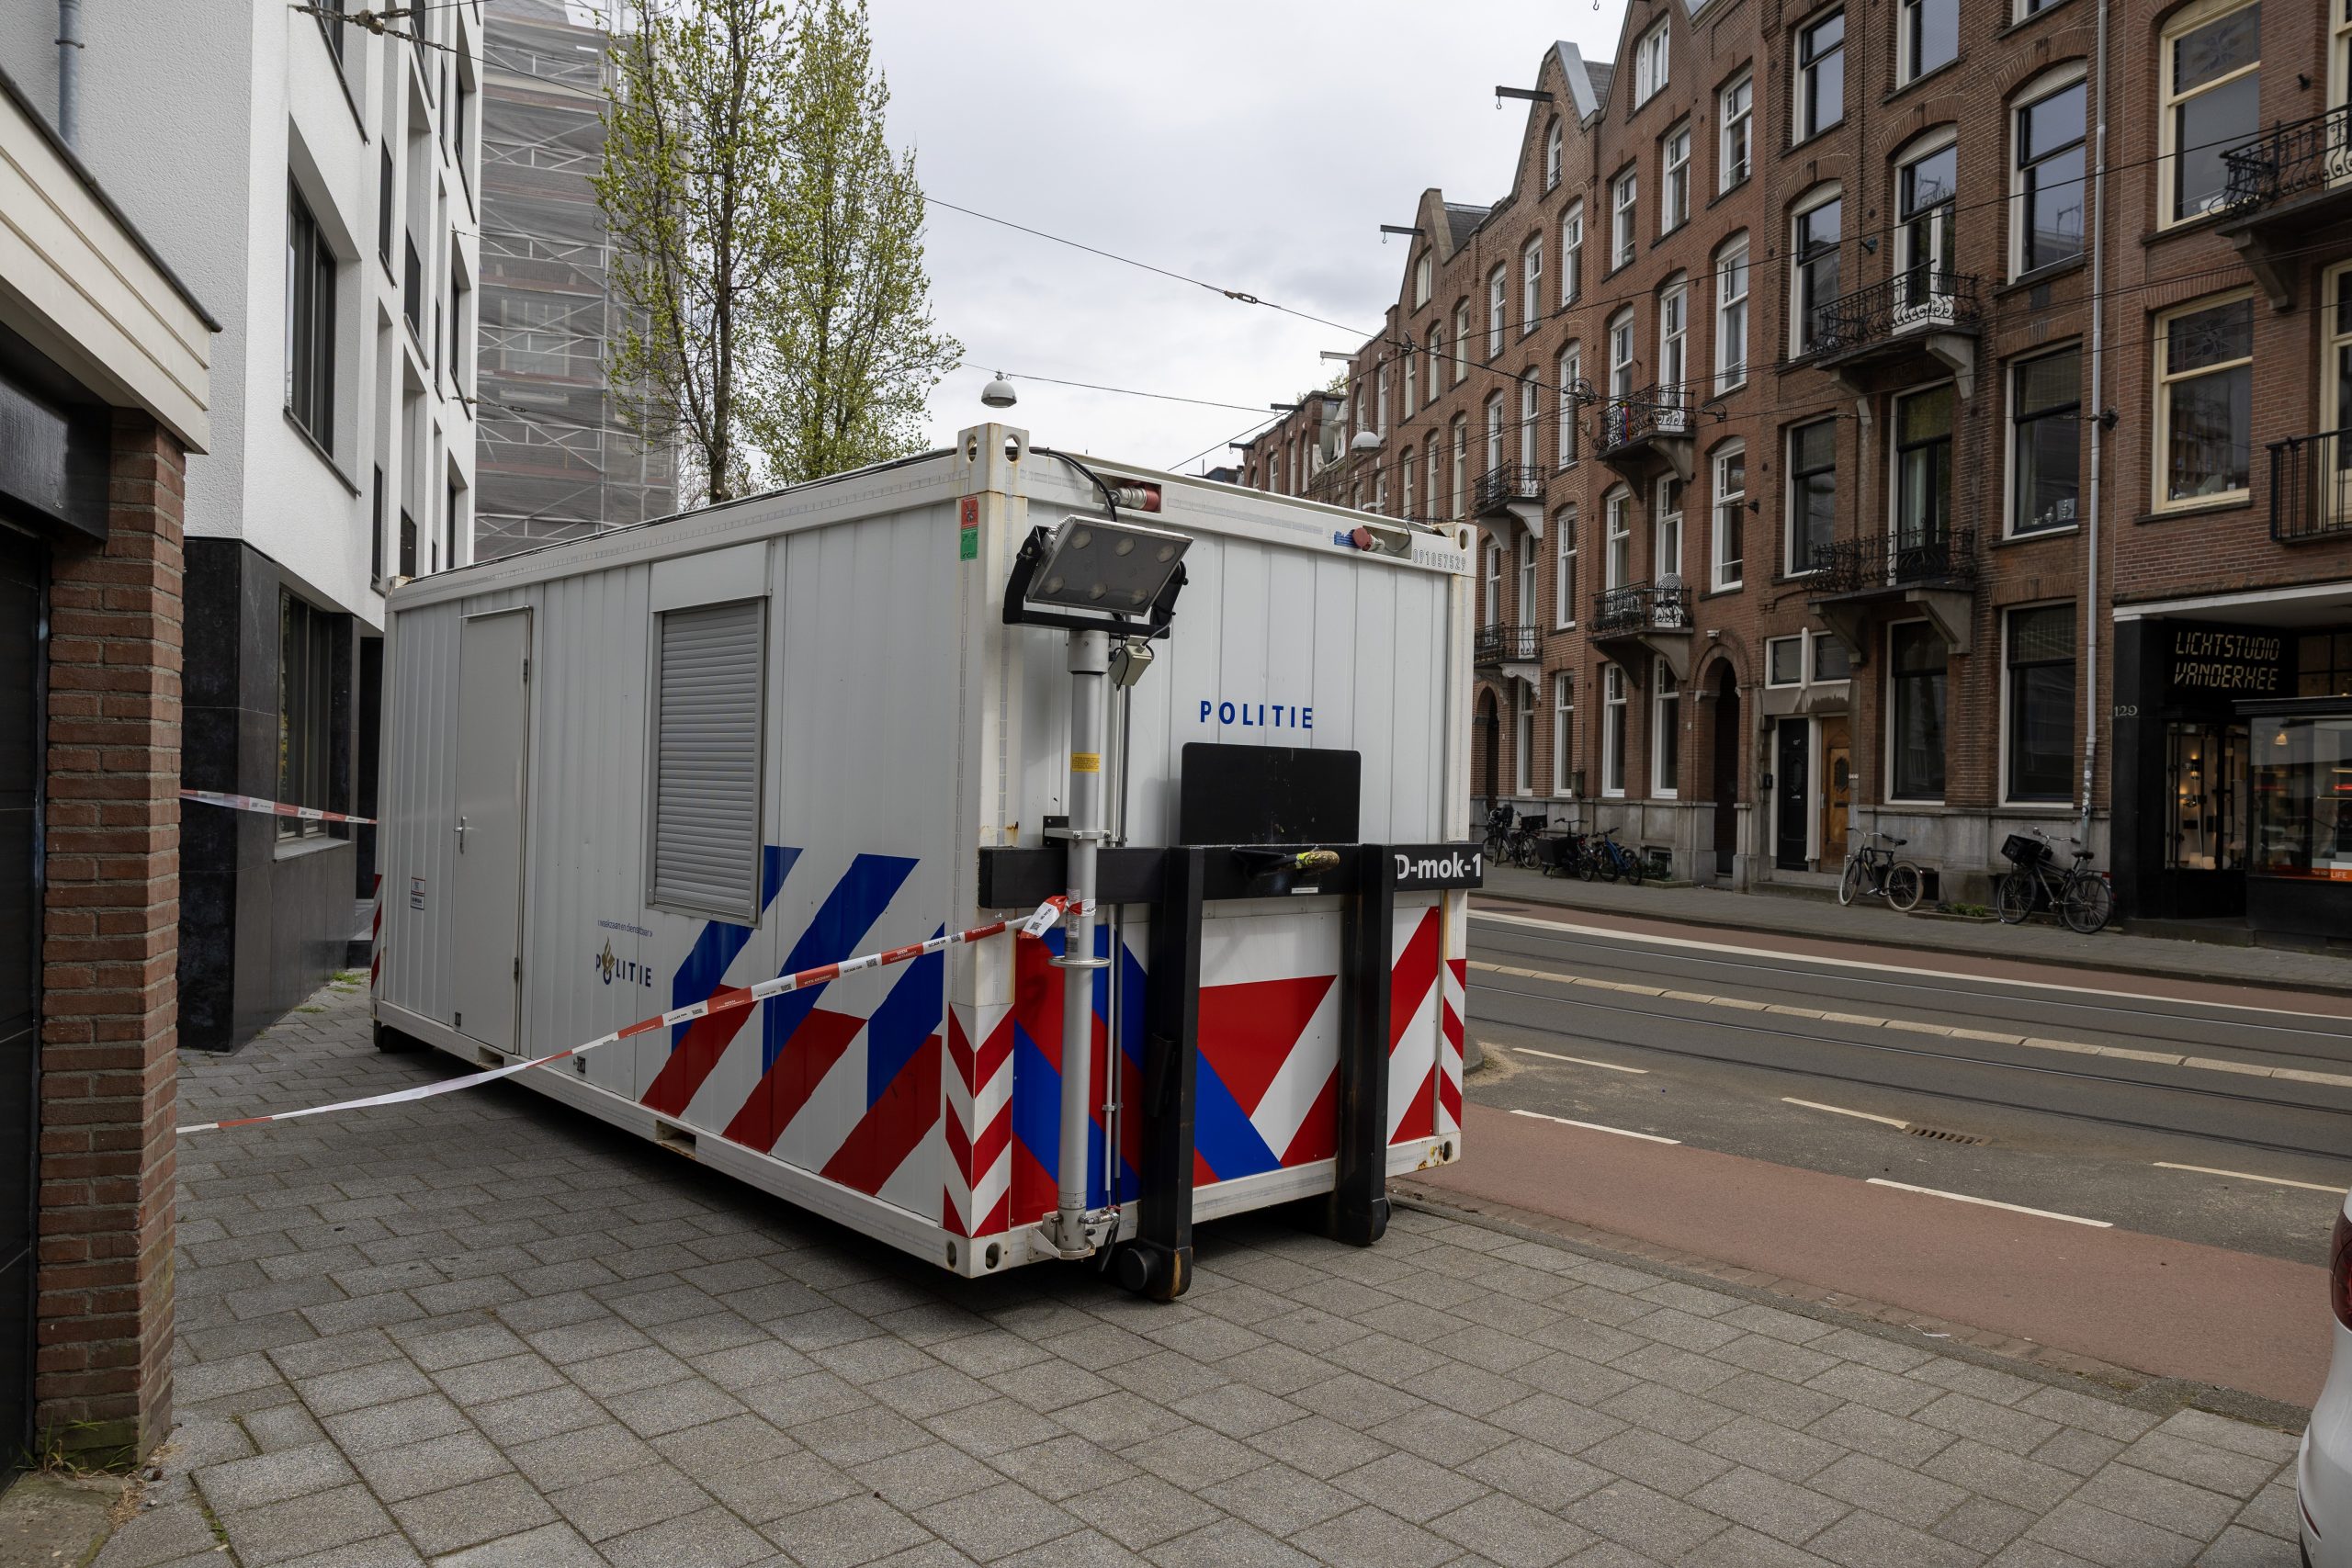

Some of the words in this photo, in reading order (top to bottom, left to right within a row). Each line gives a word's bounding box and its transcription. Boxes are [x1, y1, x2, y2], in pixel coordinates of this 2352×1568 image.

[2176, 631, 2280, 660] LICHTSTUDIO
[2174, 661, 2279, 691] VANDERHEE
[1200, 700, 1313, 729] POLITIE
[2114, 705, 2138, 716] 129
[1394, 852, 1482, 880] D-mok-1
[595, 953, 652, 987] POLITIE
